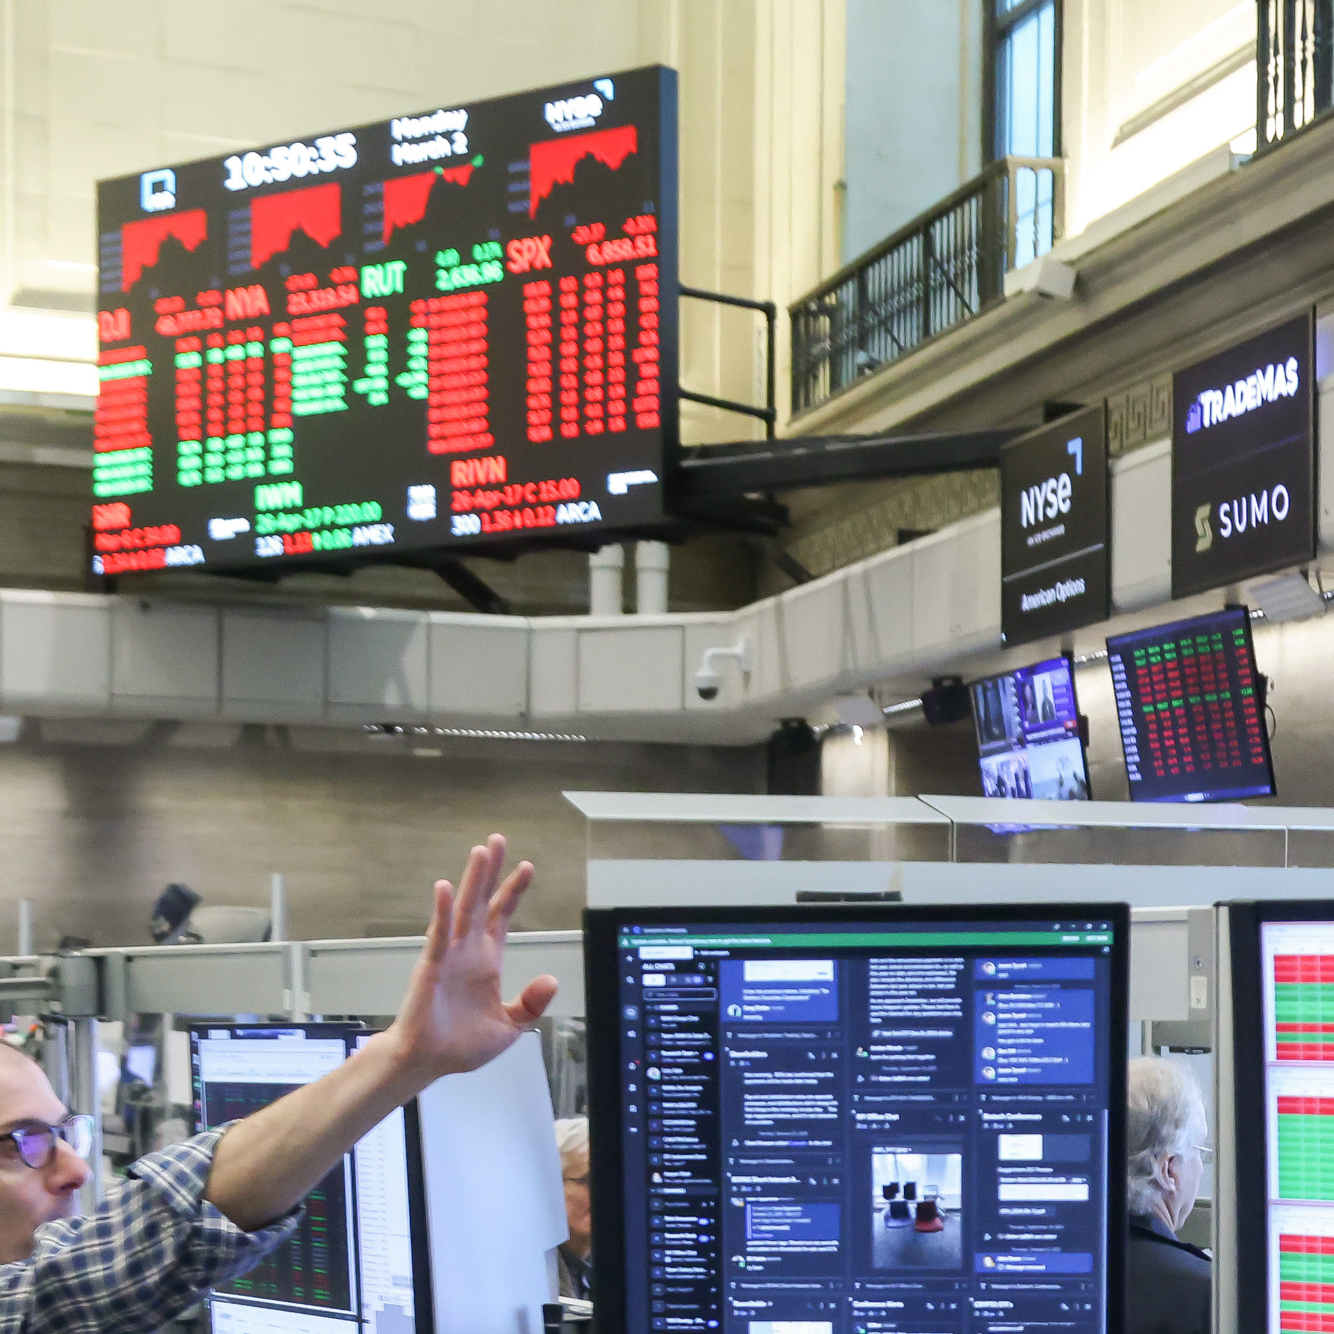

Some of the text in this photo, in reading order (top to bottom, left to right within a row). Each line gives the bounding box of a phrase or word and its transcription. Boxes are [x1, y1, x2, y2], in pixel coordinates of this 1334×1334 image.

[223, 132, 358, 191] 10:50:35
[506, 233, 553, 274] SPX
[360, 259, 408, 299] RUT
[450, 455, 508, 488] RIVN
[556, 500, 603, 525] ARCA
[1218, 483, 1291, 539] SUMO
